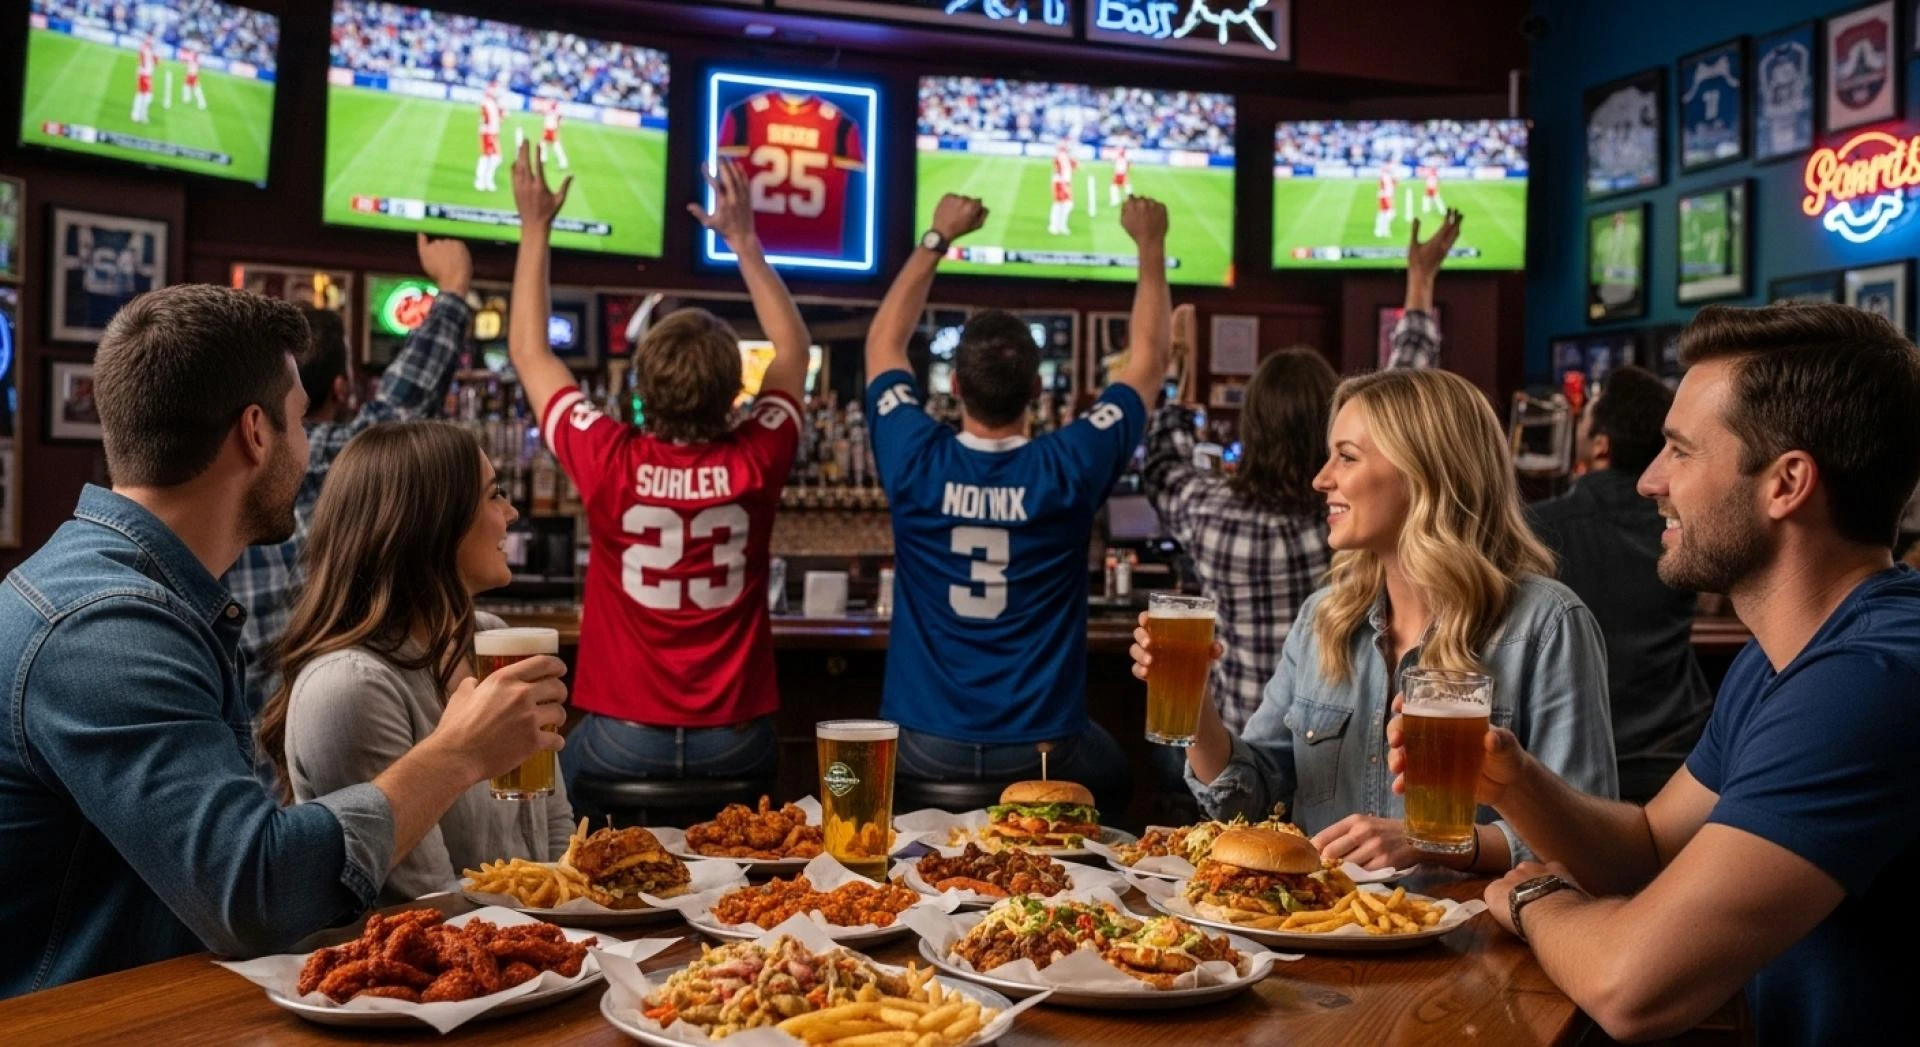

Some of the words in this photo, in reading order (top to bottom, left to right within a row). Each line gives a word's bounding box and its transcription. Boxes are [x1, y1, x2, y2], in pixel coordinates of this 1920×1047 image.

[751, 145, 828, 218] 25
[621, 503, 750, 610] 23
[948, 526, 1010, 620] 3
